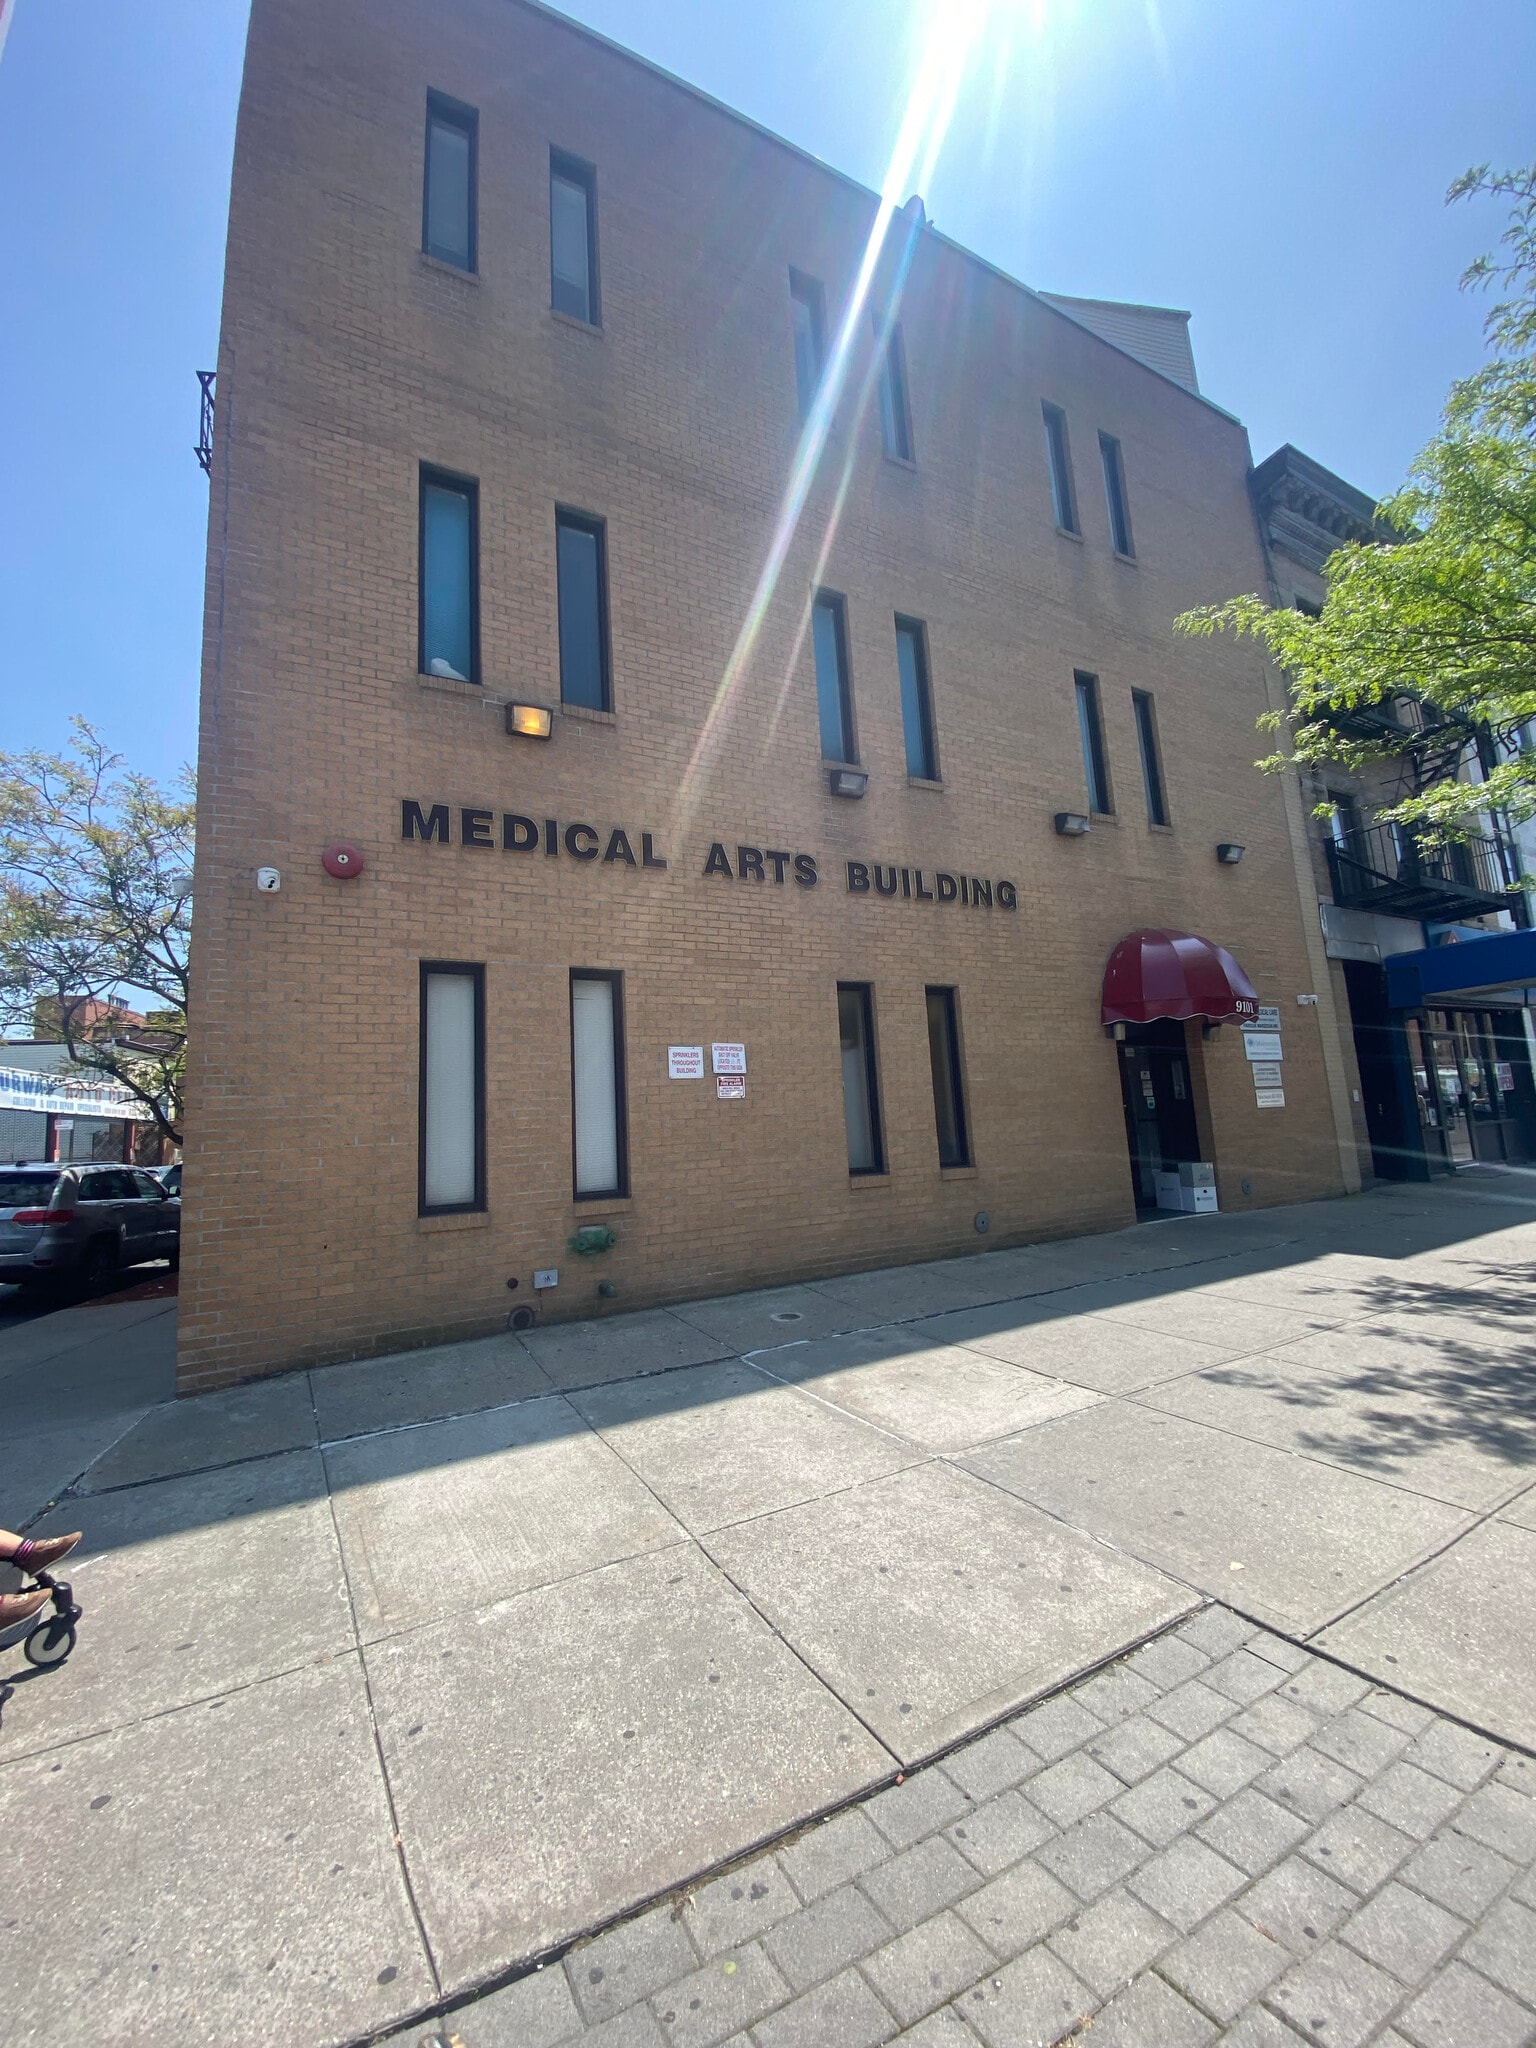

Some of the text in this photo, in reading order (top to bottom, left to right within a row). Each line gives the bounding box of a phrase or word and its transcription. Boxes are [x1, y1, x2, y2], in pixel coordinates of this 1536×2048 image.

[401, 799, 1017, 910] MEDICAL ARTS BUILDING
